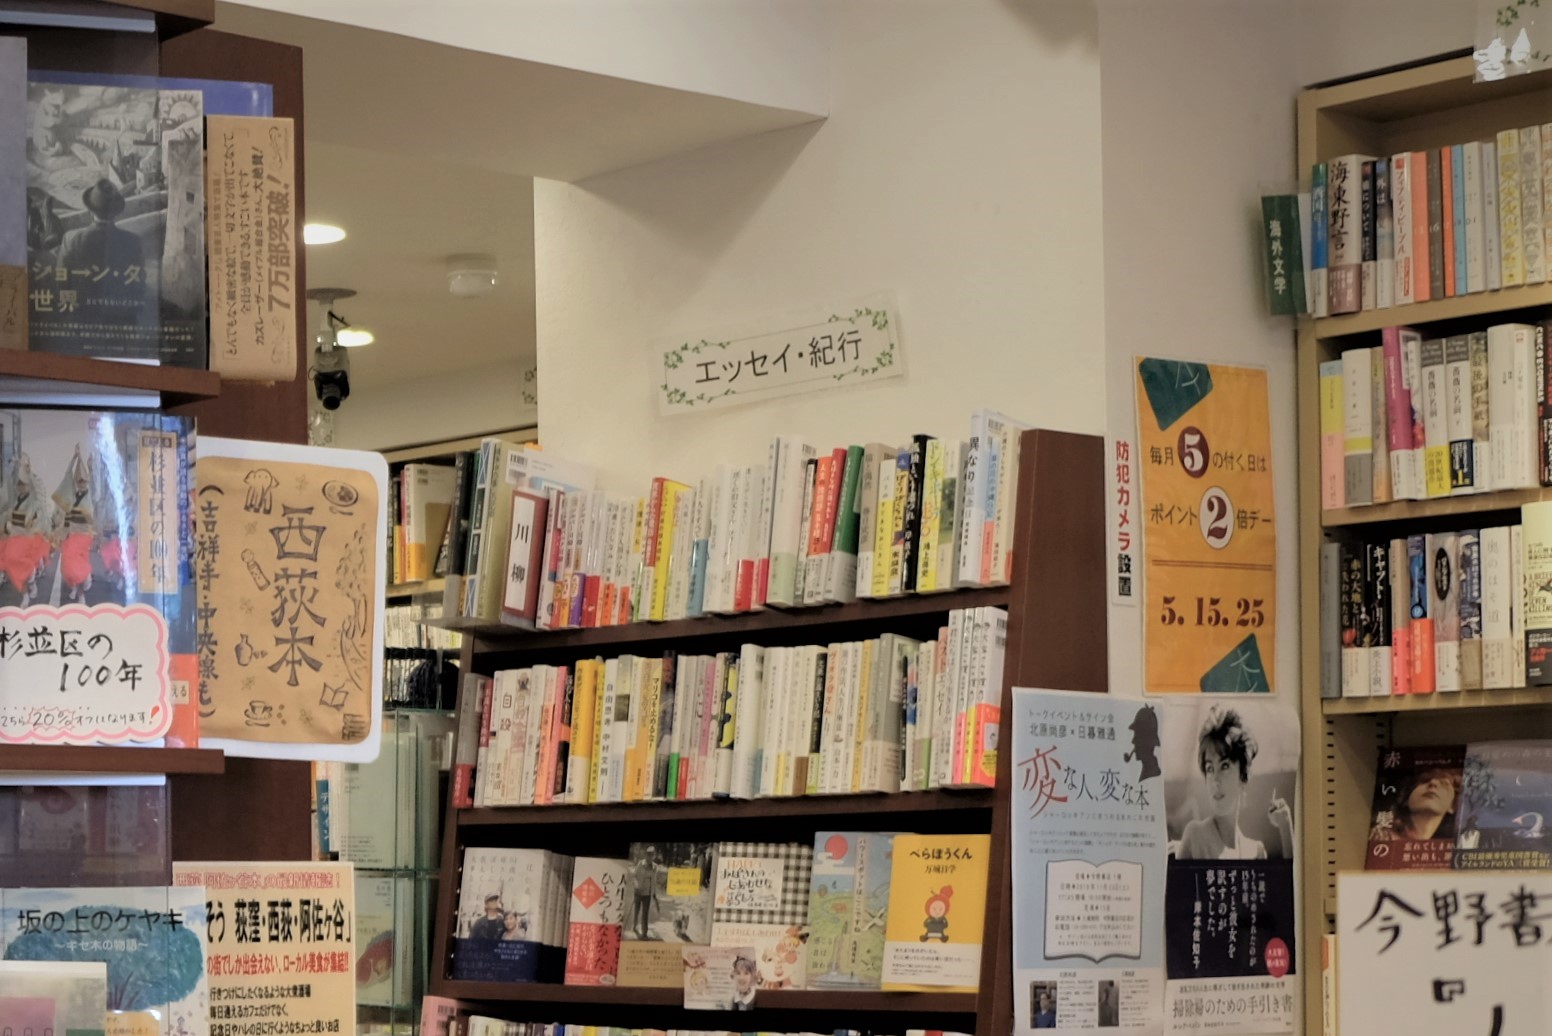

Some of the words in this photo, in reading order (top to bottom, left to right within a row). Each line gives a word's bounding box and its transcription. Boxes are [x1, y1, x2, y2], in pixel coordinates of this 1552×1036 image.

[1268, 217, 1287, 296] 海外文学
[30, 288, 78, 313] 世界
[693, 328, 865, 387] エッセイ・紀行
[510, 520, 529, 585] 川柳
[1114, 440, 1134, 598] 防犯カメラ設置
[267, 503, 328, 688] 西荻本
[58, 661, 145, 693] 100年
[1017, 744, 1151, 820] 変な人、変な本
[1373, 751, 1402, 859] 赤い髪の
[908, 846, 974, 863] べらぼうくん
[17, 908, 184, 935] 坂の上のケヤキ
[594, 871, 616, 970] ひとつもなかった
[1205, 868, 1217, 938] 夢でした。
[1216, 869, 1228, 933] 訳すのが
[1227, 869, 1239, 960] ずっと彼女を
[1354, 886, 1552, 956] 今野書
[1172, 993, 1294, 1019] 掃除婦のための手引き書
